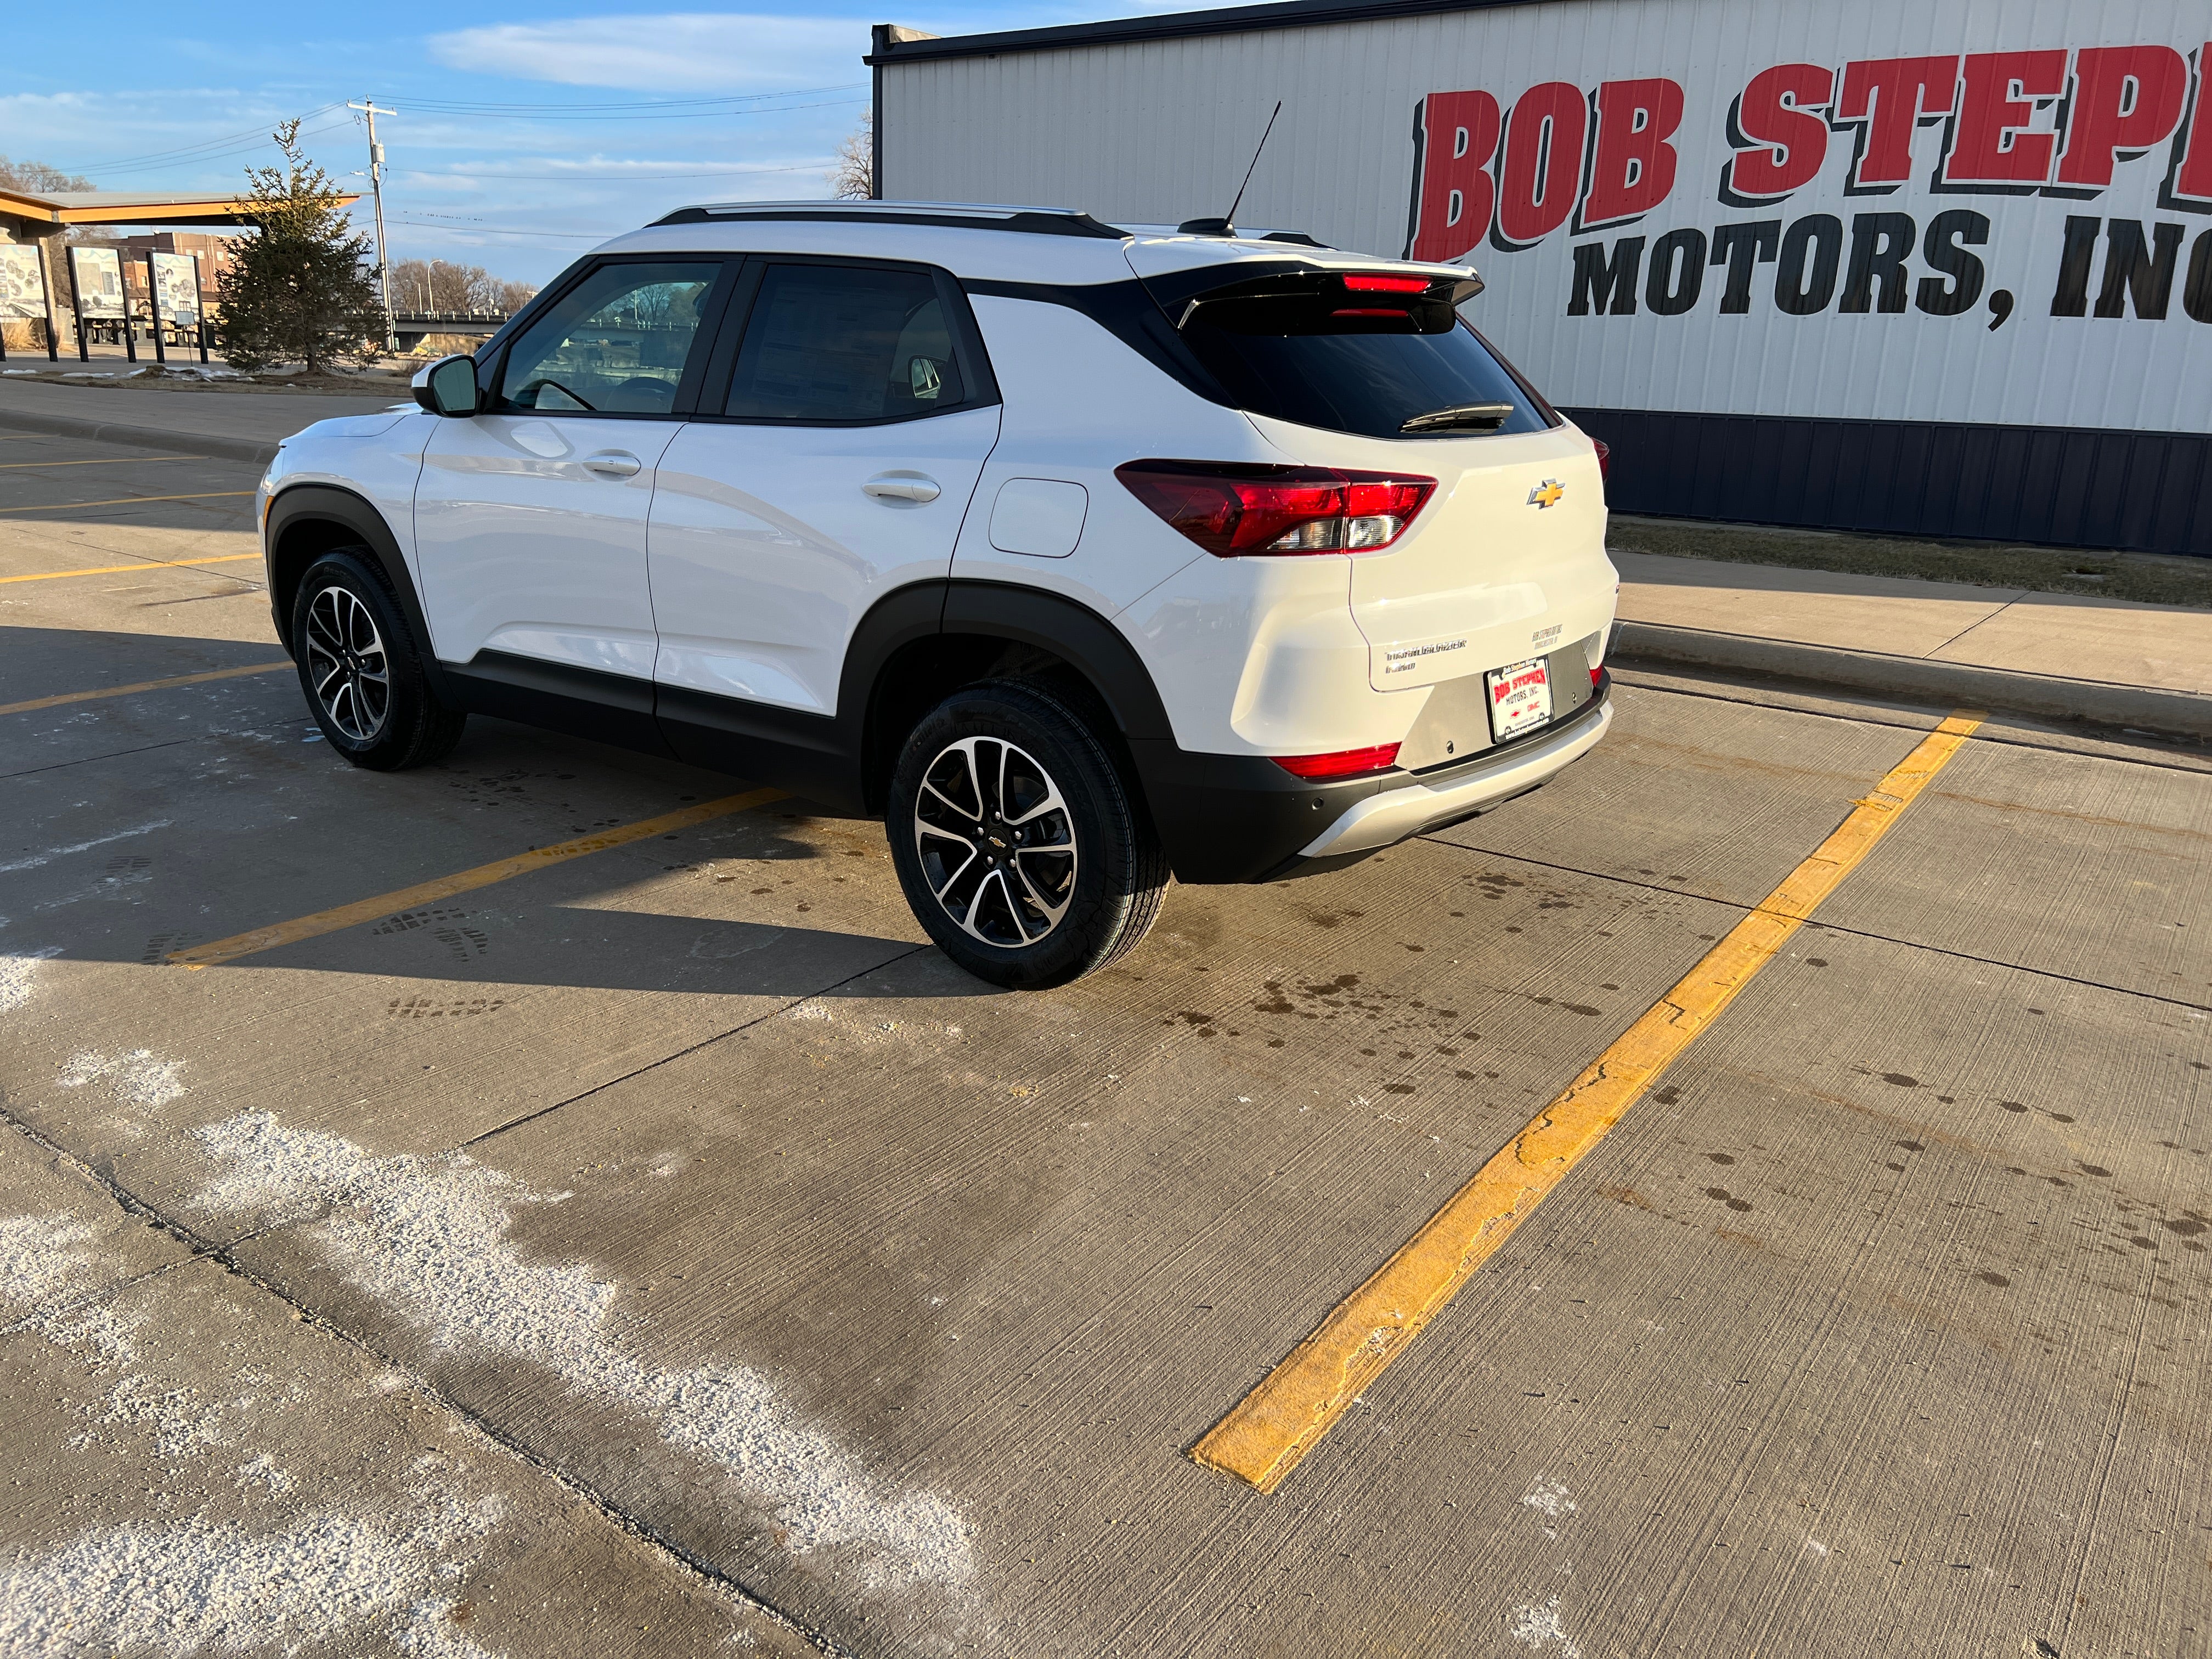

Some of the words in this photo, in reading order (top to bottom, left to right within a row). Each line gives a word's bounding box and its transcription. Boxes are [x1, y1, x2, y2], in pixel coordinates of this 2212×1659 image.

[1402, 78, 1684, 262] BOB
[1718, 42, 2212, 214] STEP
[1567, 209, 2013, 331] MOTORS,
[1493, 681, 1510, 705] BOB
[1513, 667, 1546, 690] STEPHEN
[1506, 690, 1529, 706] MOTORS,
[1529, 686, 1539, 697] INC.
[1527, 701, 1540, 712] GMC
